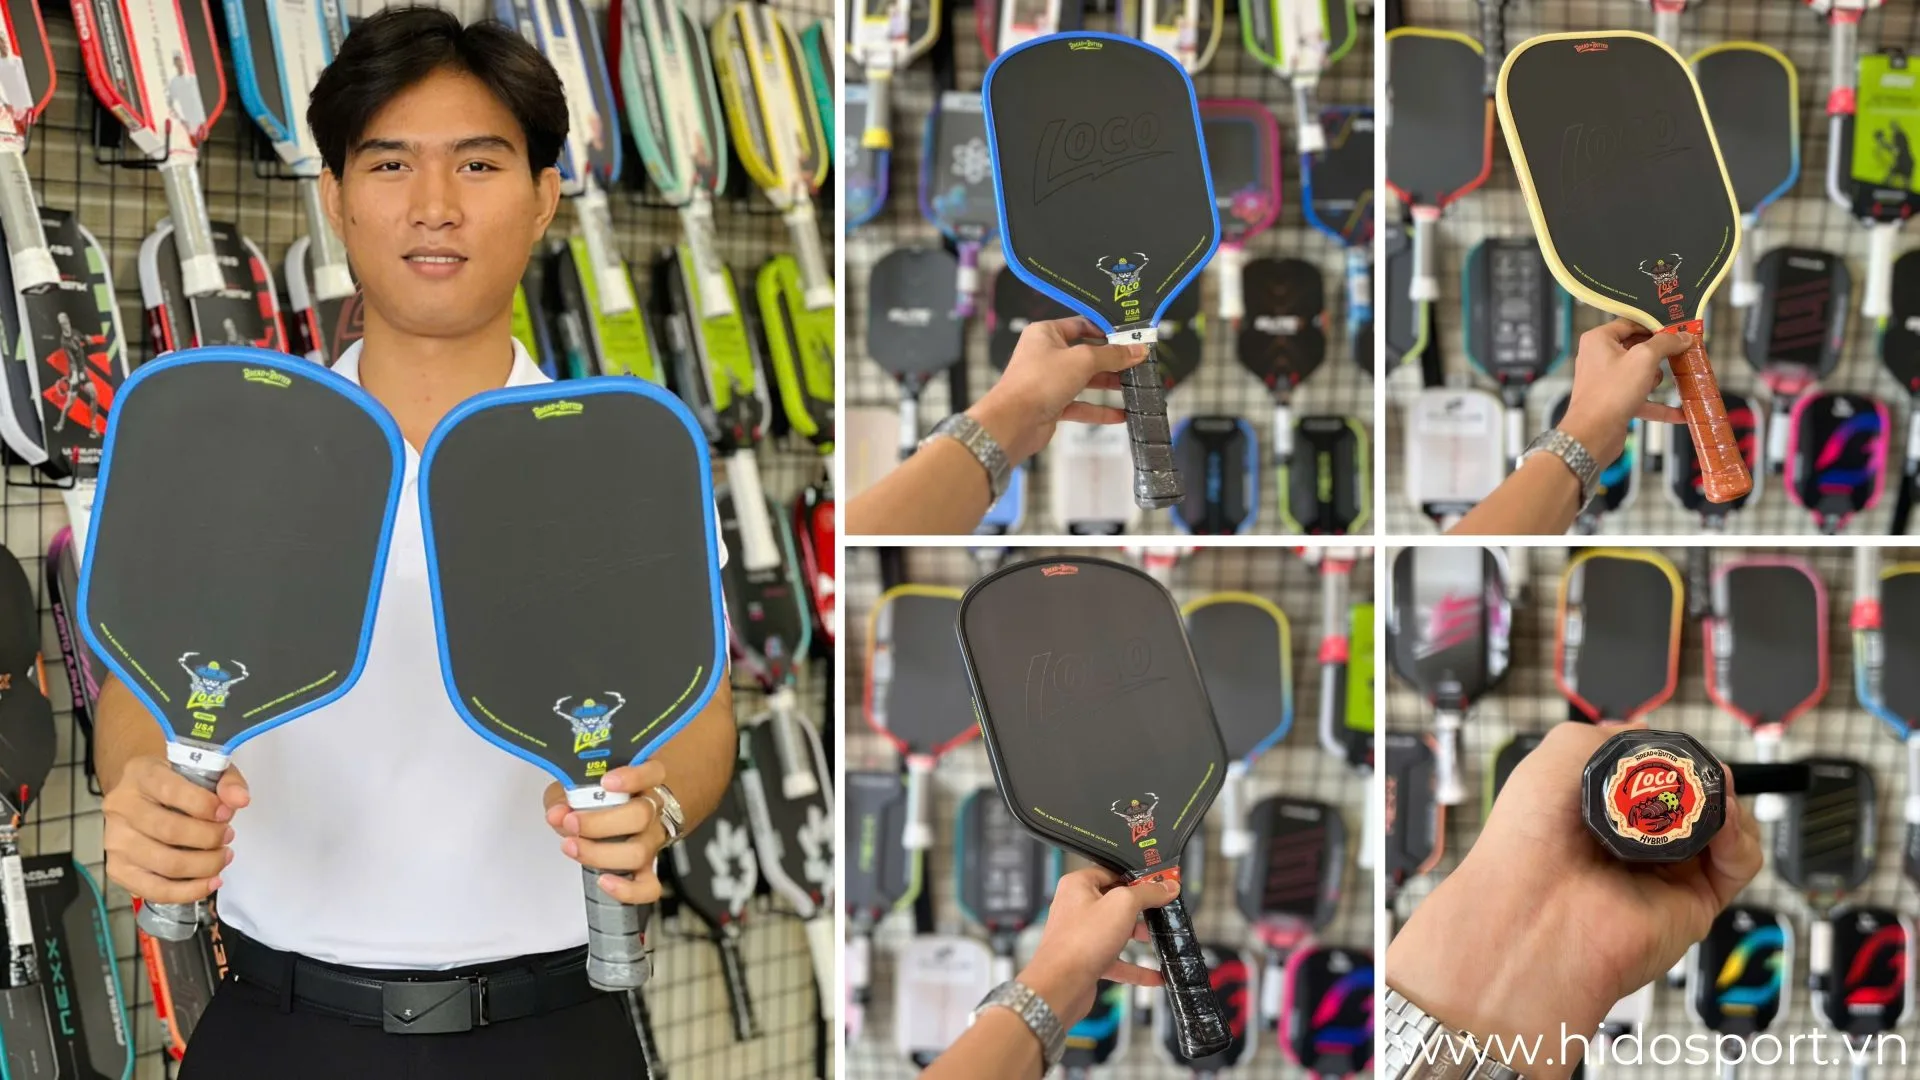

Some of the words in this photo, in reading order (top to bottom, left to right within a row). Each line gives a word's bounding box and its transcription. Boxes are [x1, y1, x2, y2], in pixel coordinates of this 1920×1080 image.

[1033, 111, 1175, 206] LOCO
[1114, 281, 1140, 302] LOCO
[1125, 307, 1141, 317] USA
[186, 690, 226, 709] LOCO
[194, 721, 215, 734] USA
[573, 728, 611, 754] LOCO
[1634, 750, 1655, 761] BREAD
[1657, 749, 1678, 763] BUTTER
[586, 759, 608, 770] USA
[1630, 770, 1681, 799] LOCO
[1640, 834, 1669, 846] HYBRID
